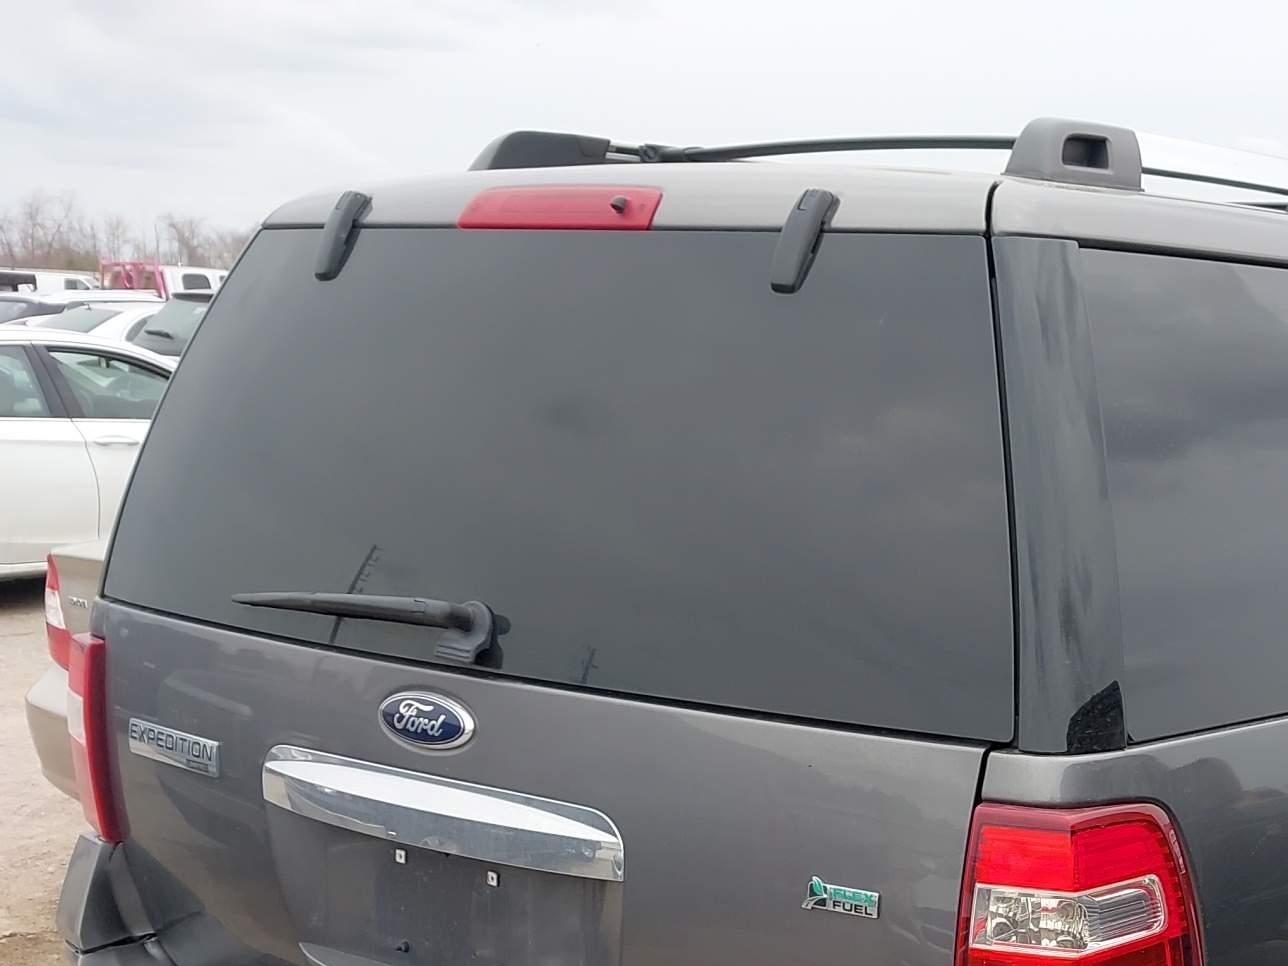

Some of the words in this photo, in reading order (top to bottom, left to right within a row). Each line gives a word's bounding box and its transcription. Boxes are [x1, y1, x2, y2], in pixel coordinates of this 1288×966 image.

[393, 699, 446, 736] Ford
[130, 723, 212, 762] EXPEDITION
[832, 900, 873, 916] FUEL
